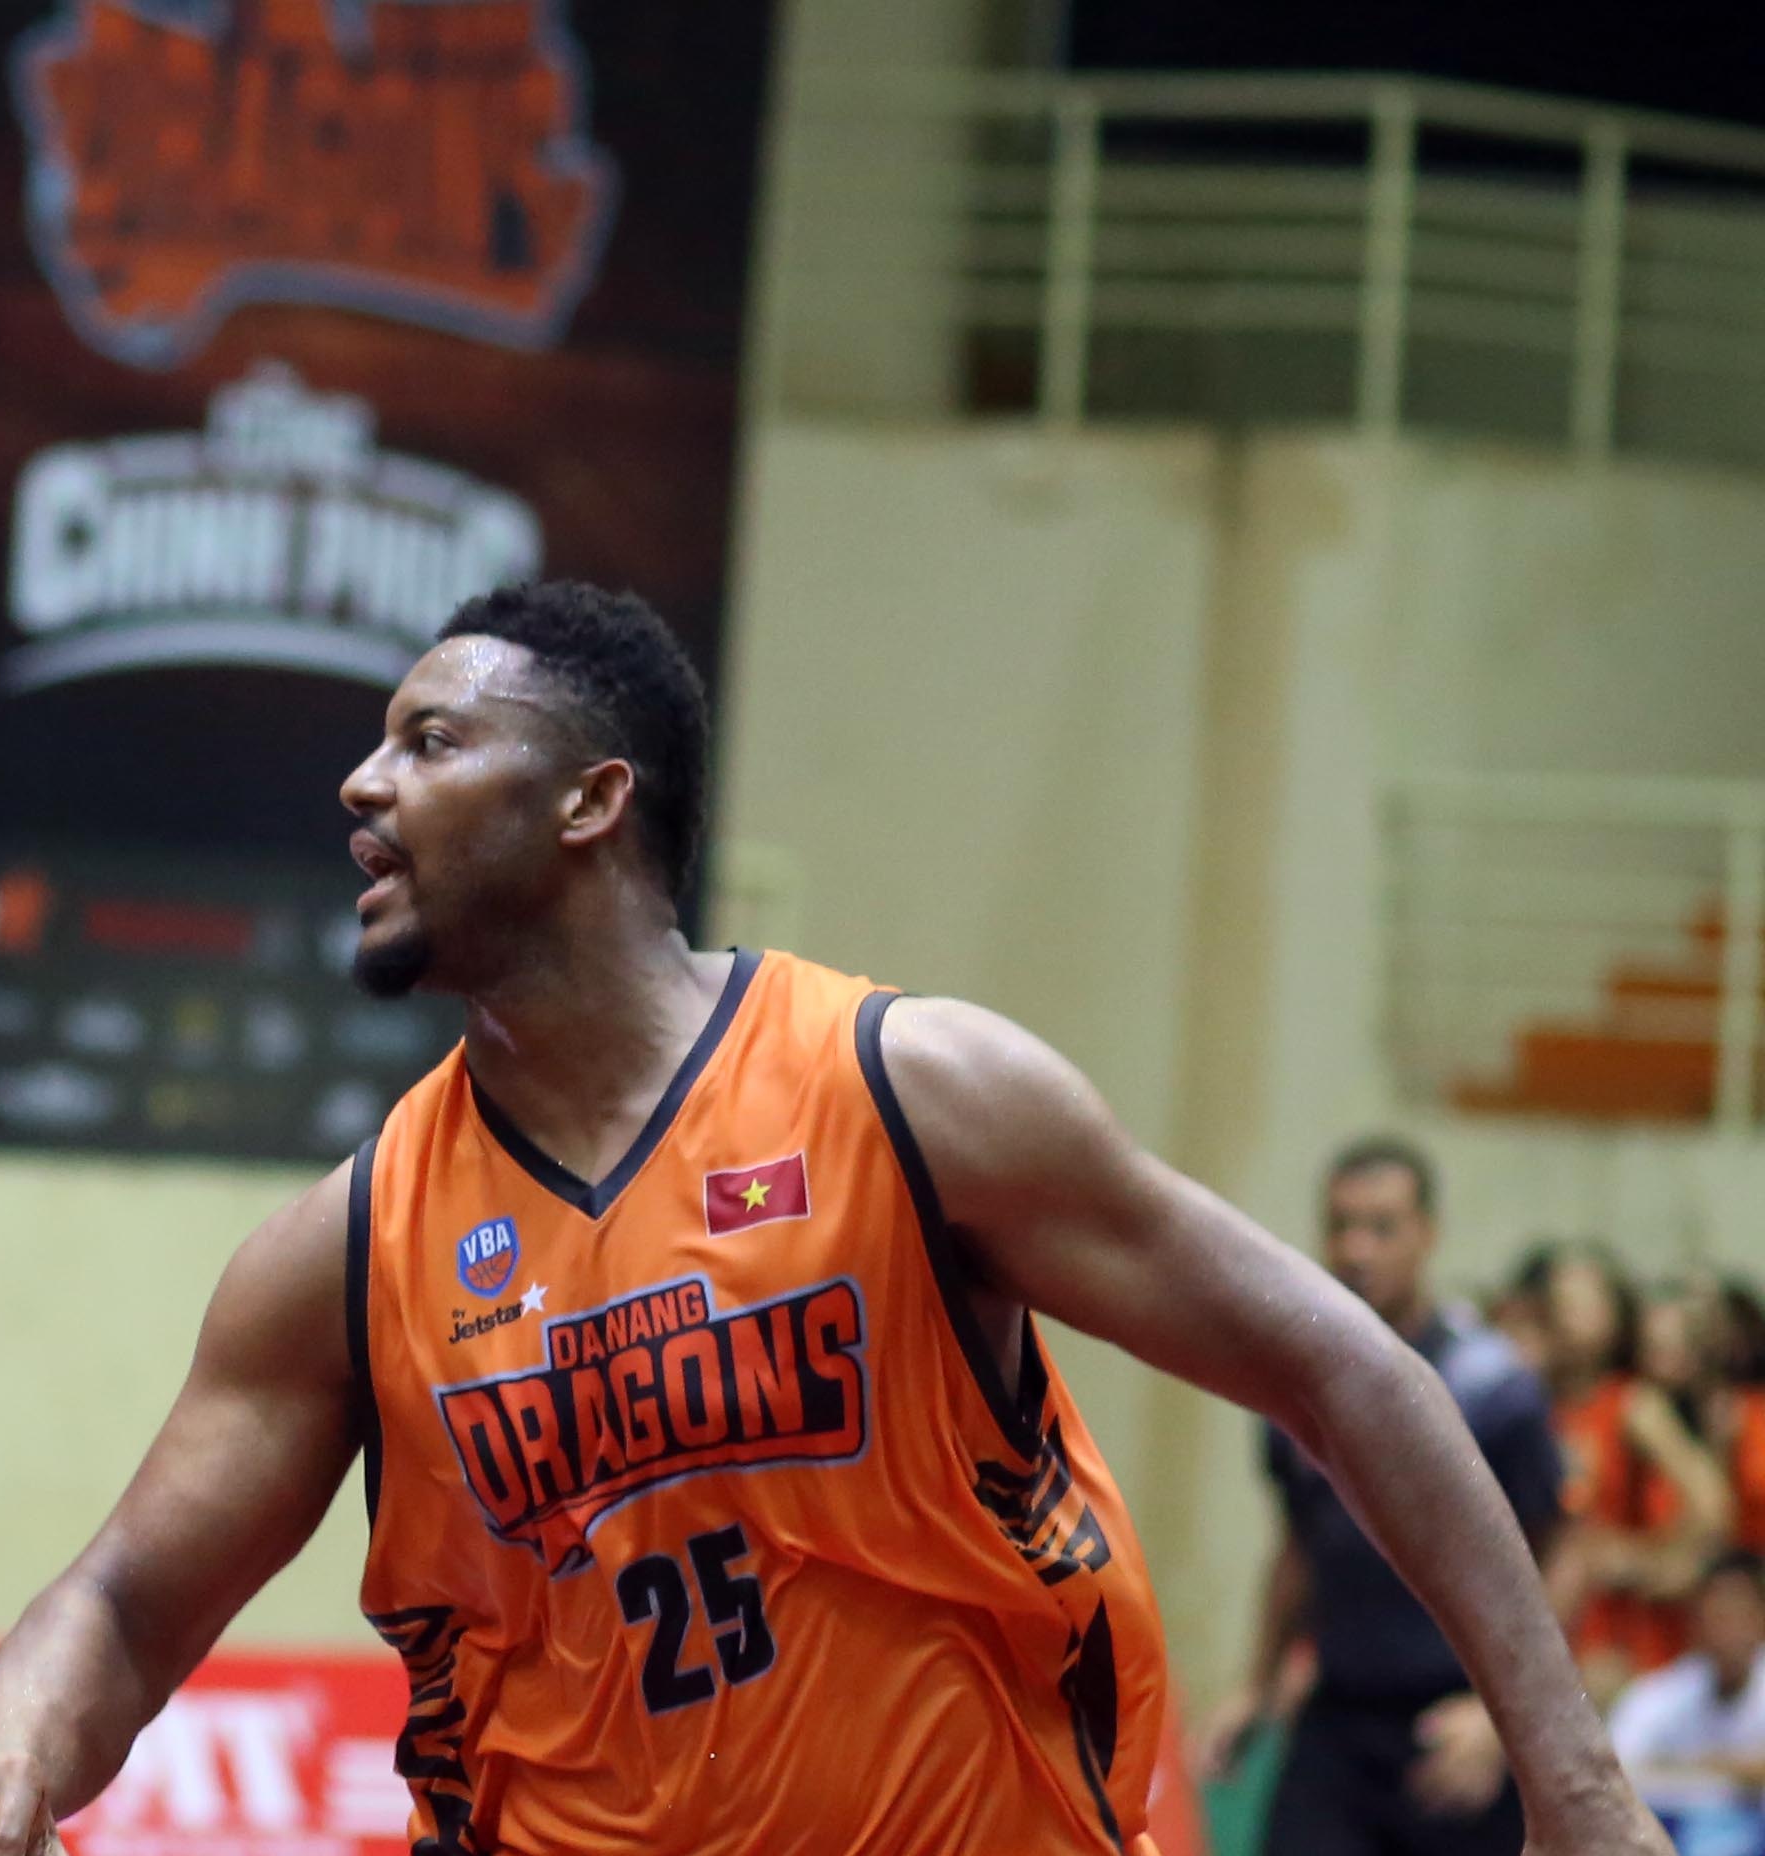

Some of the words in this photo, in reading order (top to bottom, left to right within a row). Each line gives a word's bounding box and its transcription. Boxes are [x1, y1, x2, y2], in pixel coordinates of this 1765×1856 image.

[463, 1222, 511, 1265] VBA
[449, 1301, 522, 1344] Jetstar
[443, 1286, 863, 1528] DRAGONS
[615, 1518, 778, 1717] 25
